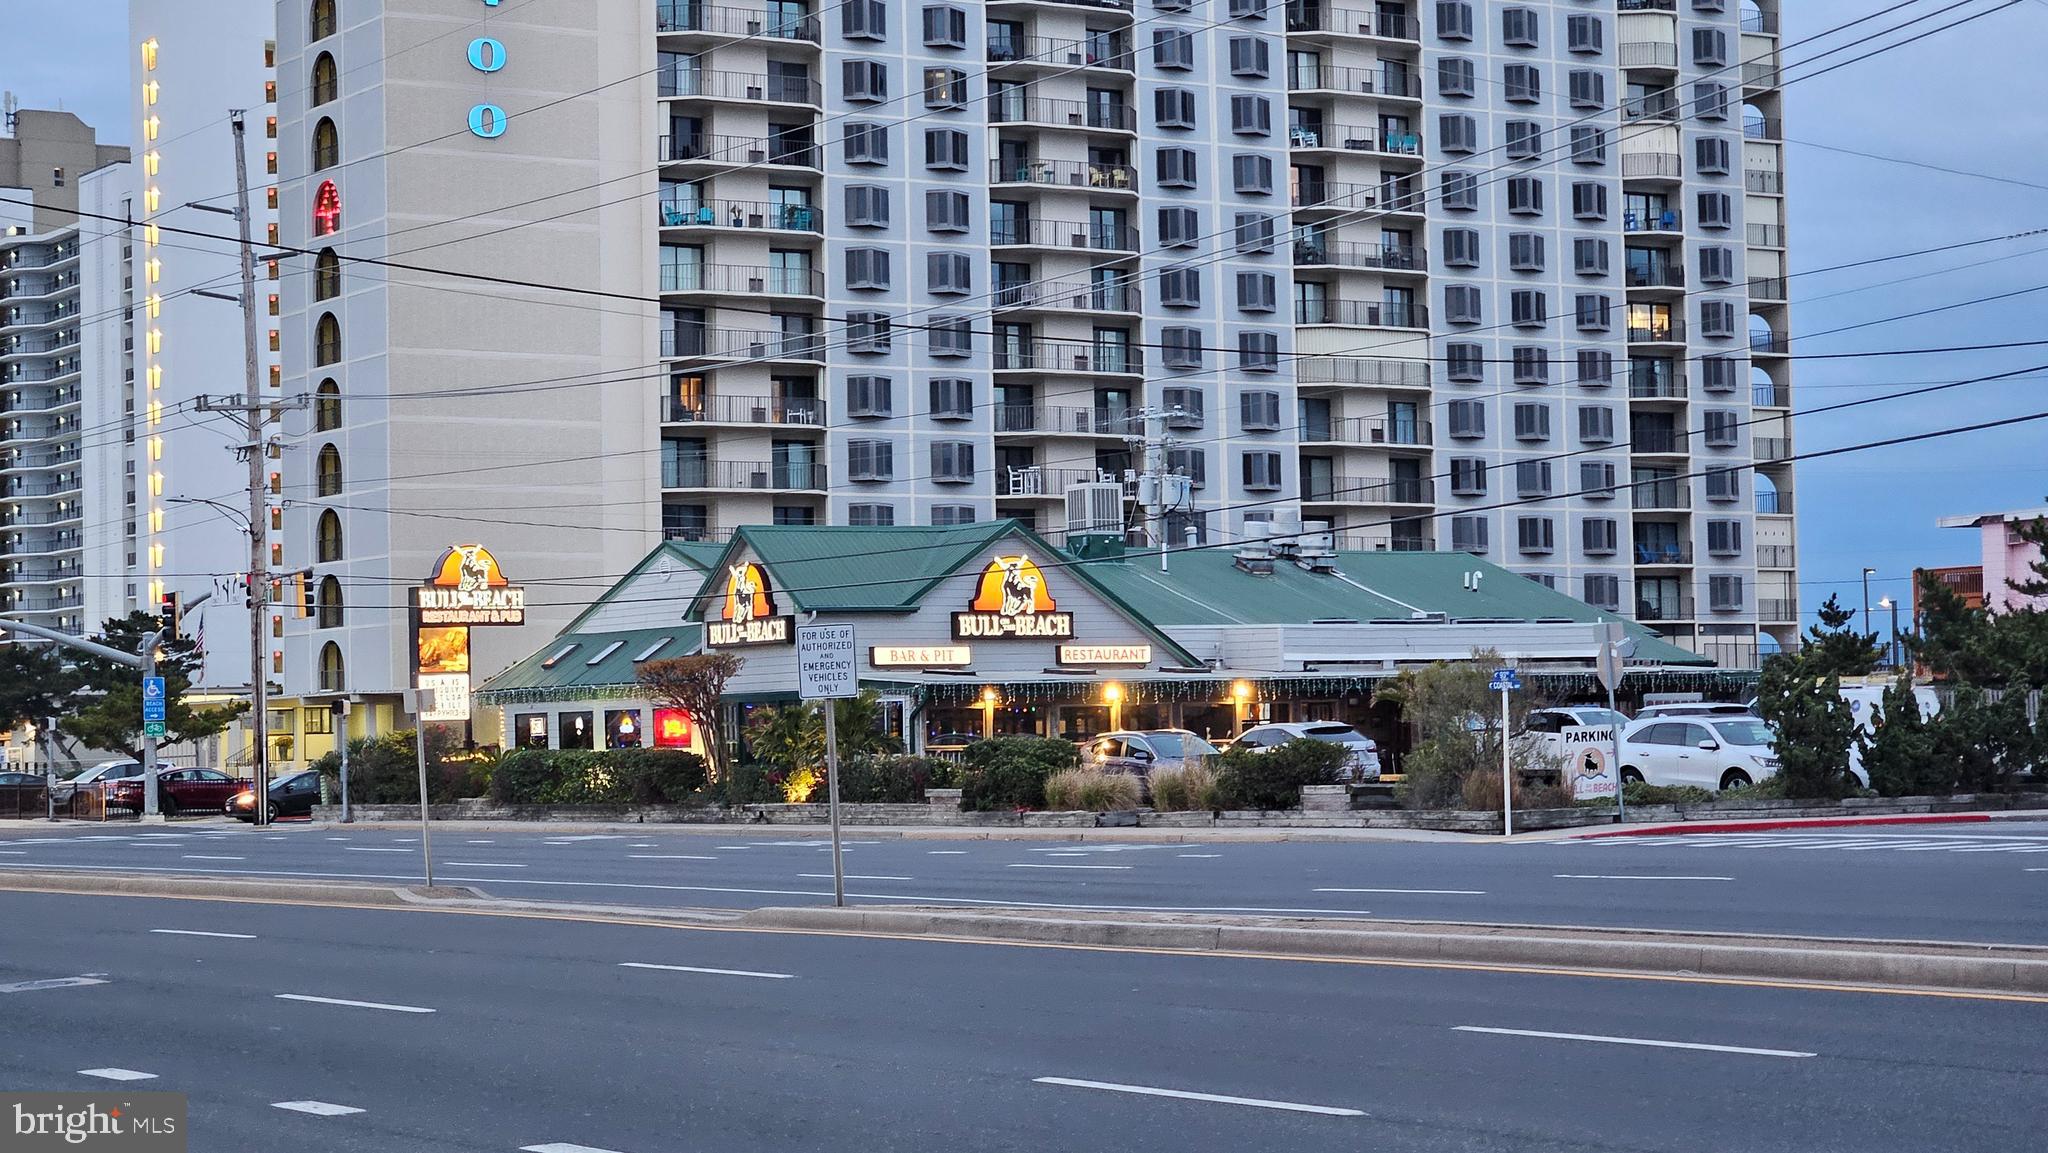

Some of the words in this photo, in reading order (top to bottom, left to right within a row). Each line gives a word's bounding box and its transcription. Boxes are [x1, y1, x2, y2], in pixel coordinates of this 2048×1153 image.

[472, 590, 525, 610] BEACH
[421, 610, 490, 623] RESTAURANT
[490, 610, 500, 623] &
[500, 610, 522, 622] PUB
[958, 615, 1004, 636] BULL
[1014, 615, 1071, 636] BEACH
[708, 625, 741, 645] BULL
[746, 620, 787, 643] BEACH
[802, 632, 817, 641] FOR
[819, 630, 836, 640] USE
[839, 630, 850, 639] OF
[801, 641, 852, 651] AUTHORIZED
[890, 650, 917, 662] BAR
[920, 650, 930, 662] &
[934, 650, 954, 662] PIT
[1064, 649, 1147, 660] RESTAURANT
[803, 661, 851, 671] EMERGENCY
[808, 671, 848, 682] VEHICLES
[818, 683, 839, 692] ONLY
